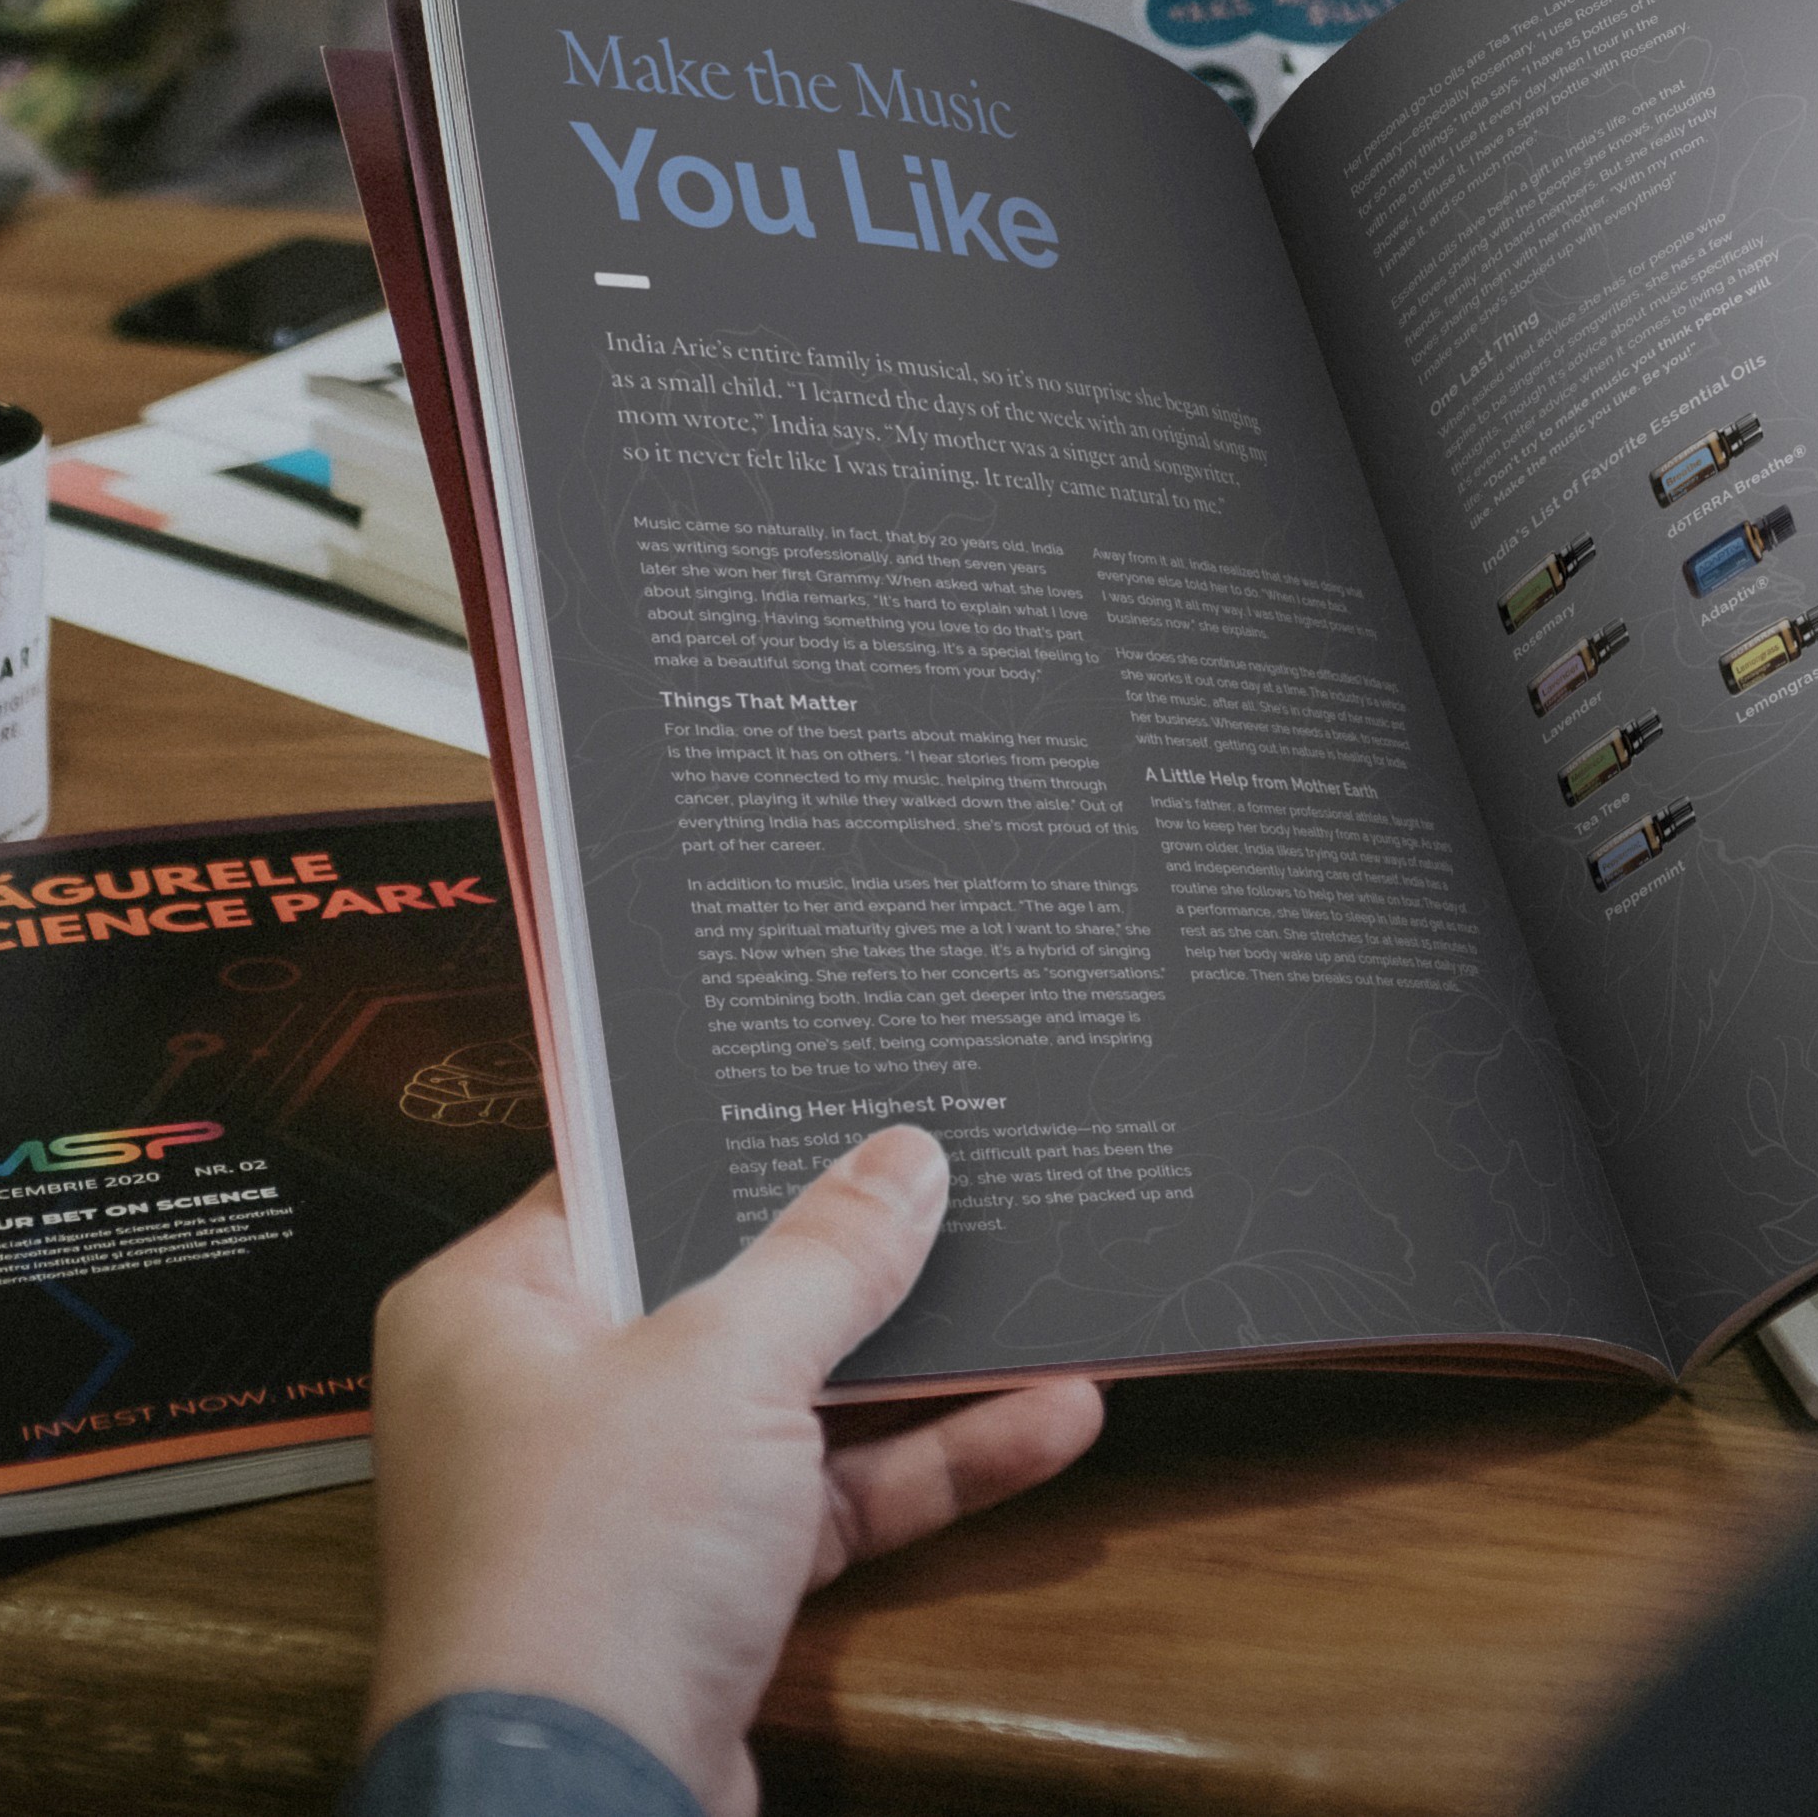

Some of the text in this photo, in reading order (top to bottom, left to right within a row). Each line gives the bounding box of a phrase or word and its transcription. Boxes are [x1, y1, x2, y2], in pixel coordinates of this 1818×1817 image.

[556, 29, 1018, 139] Make the Music
[1343, 156, 1363, 179] Her
[1362, 107, 1411, 161] personal
[1410, 83, 1443, 118] go-to
[1444, 66, 1466, 87] oils
[1465, 50, 1486, 70] are
[1486, 32, 1511, 54] Tea
[568, 120, 1060, 270] You Like
[606, 332, 665, 355] India
[738, 344, 802, 365] entire
[807, 347, 870, 377] family
[876, 353, 892, 372] is
[897, 359, 978, 385] musical,
[982, 370, 1003, 385] so
[1039, 376, 1061, 392] no
[1066, 380, 1132, 404] surprise
[1135, 387, 1162, 410] she
[1164, 391, 1209, 419] began
[1212, 403, 1261, 435] singing
[1430, 311, 1541, 417] One Last Thing
[617, 408, 678, 427] mom
[771, 414, 828, 438] India
[833, 424, 881, 446] says.
[933, 431, 1006, 453] mother
[1010, 439, 1046, 458] was
[1051, 444, 1060, 459] a
[1063, 442, 1116, 470] singer
[1119, 453, 1151, 472] and
[1153, 458, 1240, 488] songwriter,
[1531, 495, 1561, 529] List
[1562, 478, 1581, 501] of
[1581, 431, 1648, 487] Favorite
[1649, 375, 1731, 436] Essential
[1730, 353, 1768, 382] Oils
[633, 516, 682, 533] Music
[685, 521, 730, 534] came
[734, 523, 753, 535] so
[831, 526, 846, 539] in
[886, 530, 915, 544] that
[918, 532, 936, 548] by
[939, 535, 958, 548] 20
[960, 537, 1000, 552] years
[1030, 541, 1064, 556] India
[1512, 602, 1577, 662] Rosemary
[659, 691, 858, 713] Things That Matter
[1541, 690, 1603, 745] Lavender
[1145, 767, 1379, 800] A Little Help from Mother Earth
[1574, 791, 1631, 837] Tea Tree
[270, 877, 497, 924] PARK
[1604, 859, 1687, 921] Peppermint
[715, 1058, 981, 1081] others to be true to who they are.
[721, 1095, 1007, 1122] Finding Her Highest Power
[105, 1172, 160, 1188] 2020
[195, 1164, 234, 1177] NR.
[239, 1159, 268, 1172] 02
[42, 1208, 98, 1226] BET
[105, 1203, 149, 1218] ON
[156, 1187, 279, 1212] SCIENCE
[115, 1221, 171, 1237] Science
[174, 1216, 205, 1229] Park
[22, 1406, 155, 1441] INVEST
